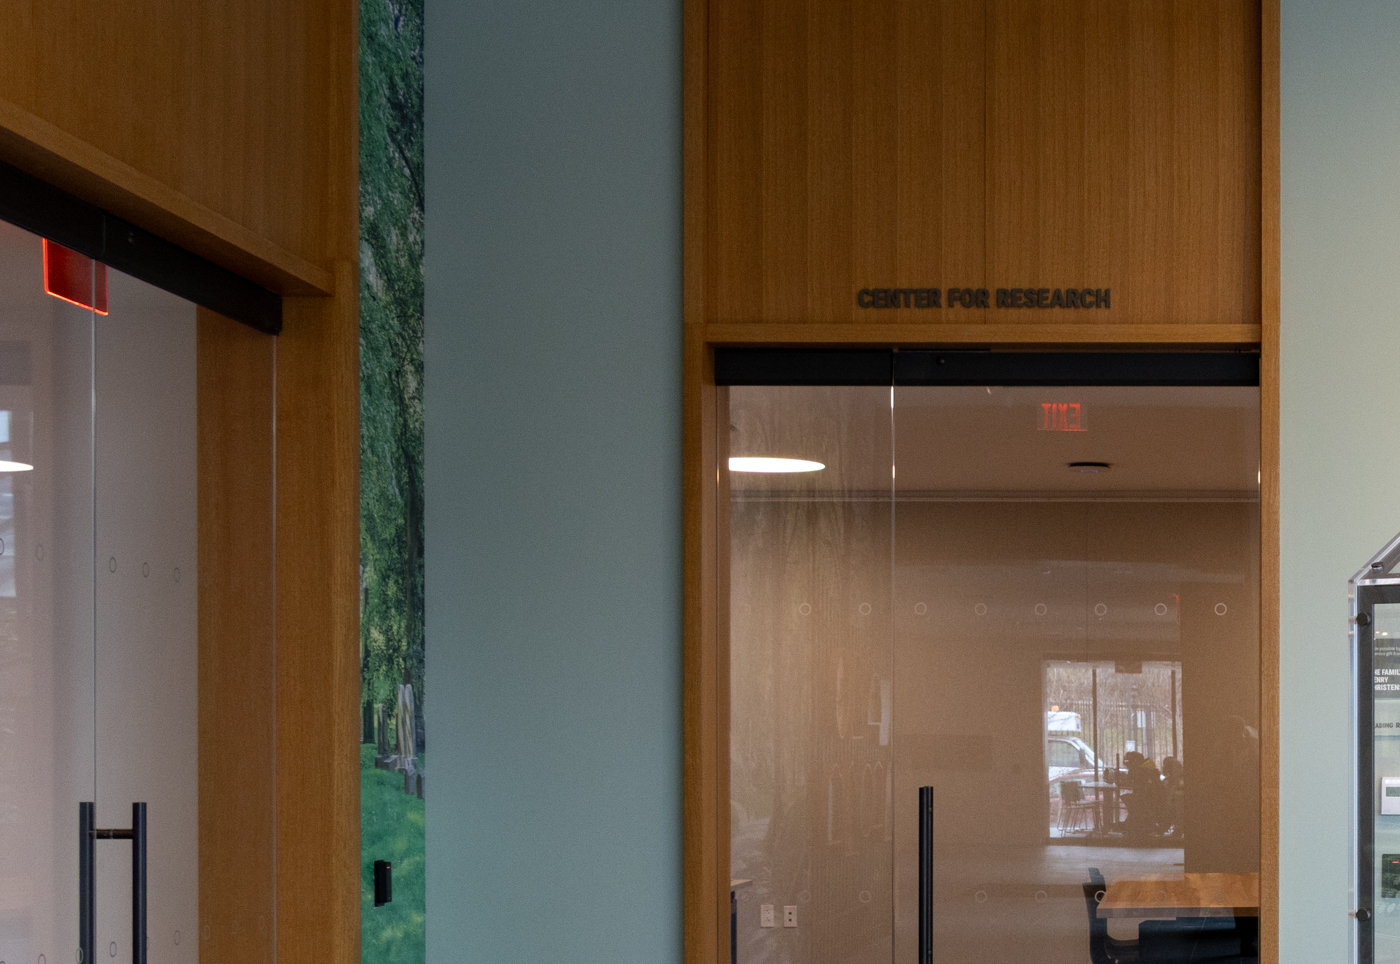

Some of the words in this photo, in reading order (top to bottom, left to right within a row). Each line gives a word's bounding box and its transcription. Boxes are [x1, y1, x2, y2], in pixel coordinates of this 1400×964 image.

[858, 288, 942, 308] CENTER
[948, 288, 990, 308] FOR
[996, 288, 1111, 308] RESEARCH
